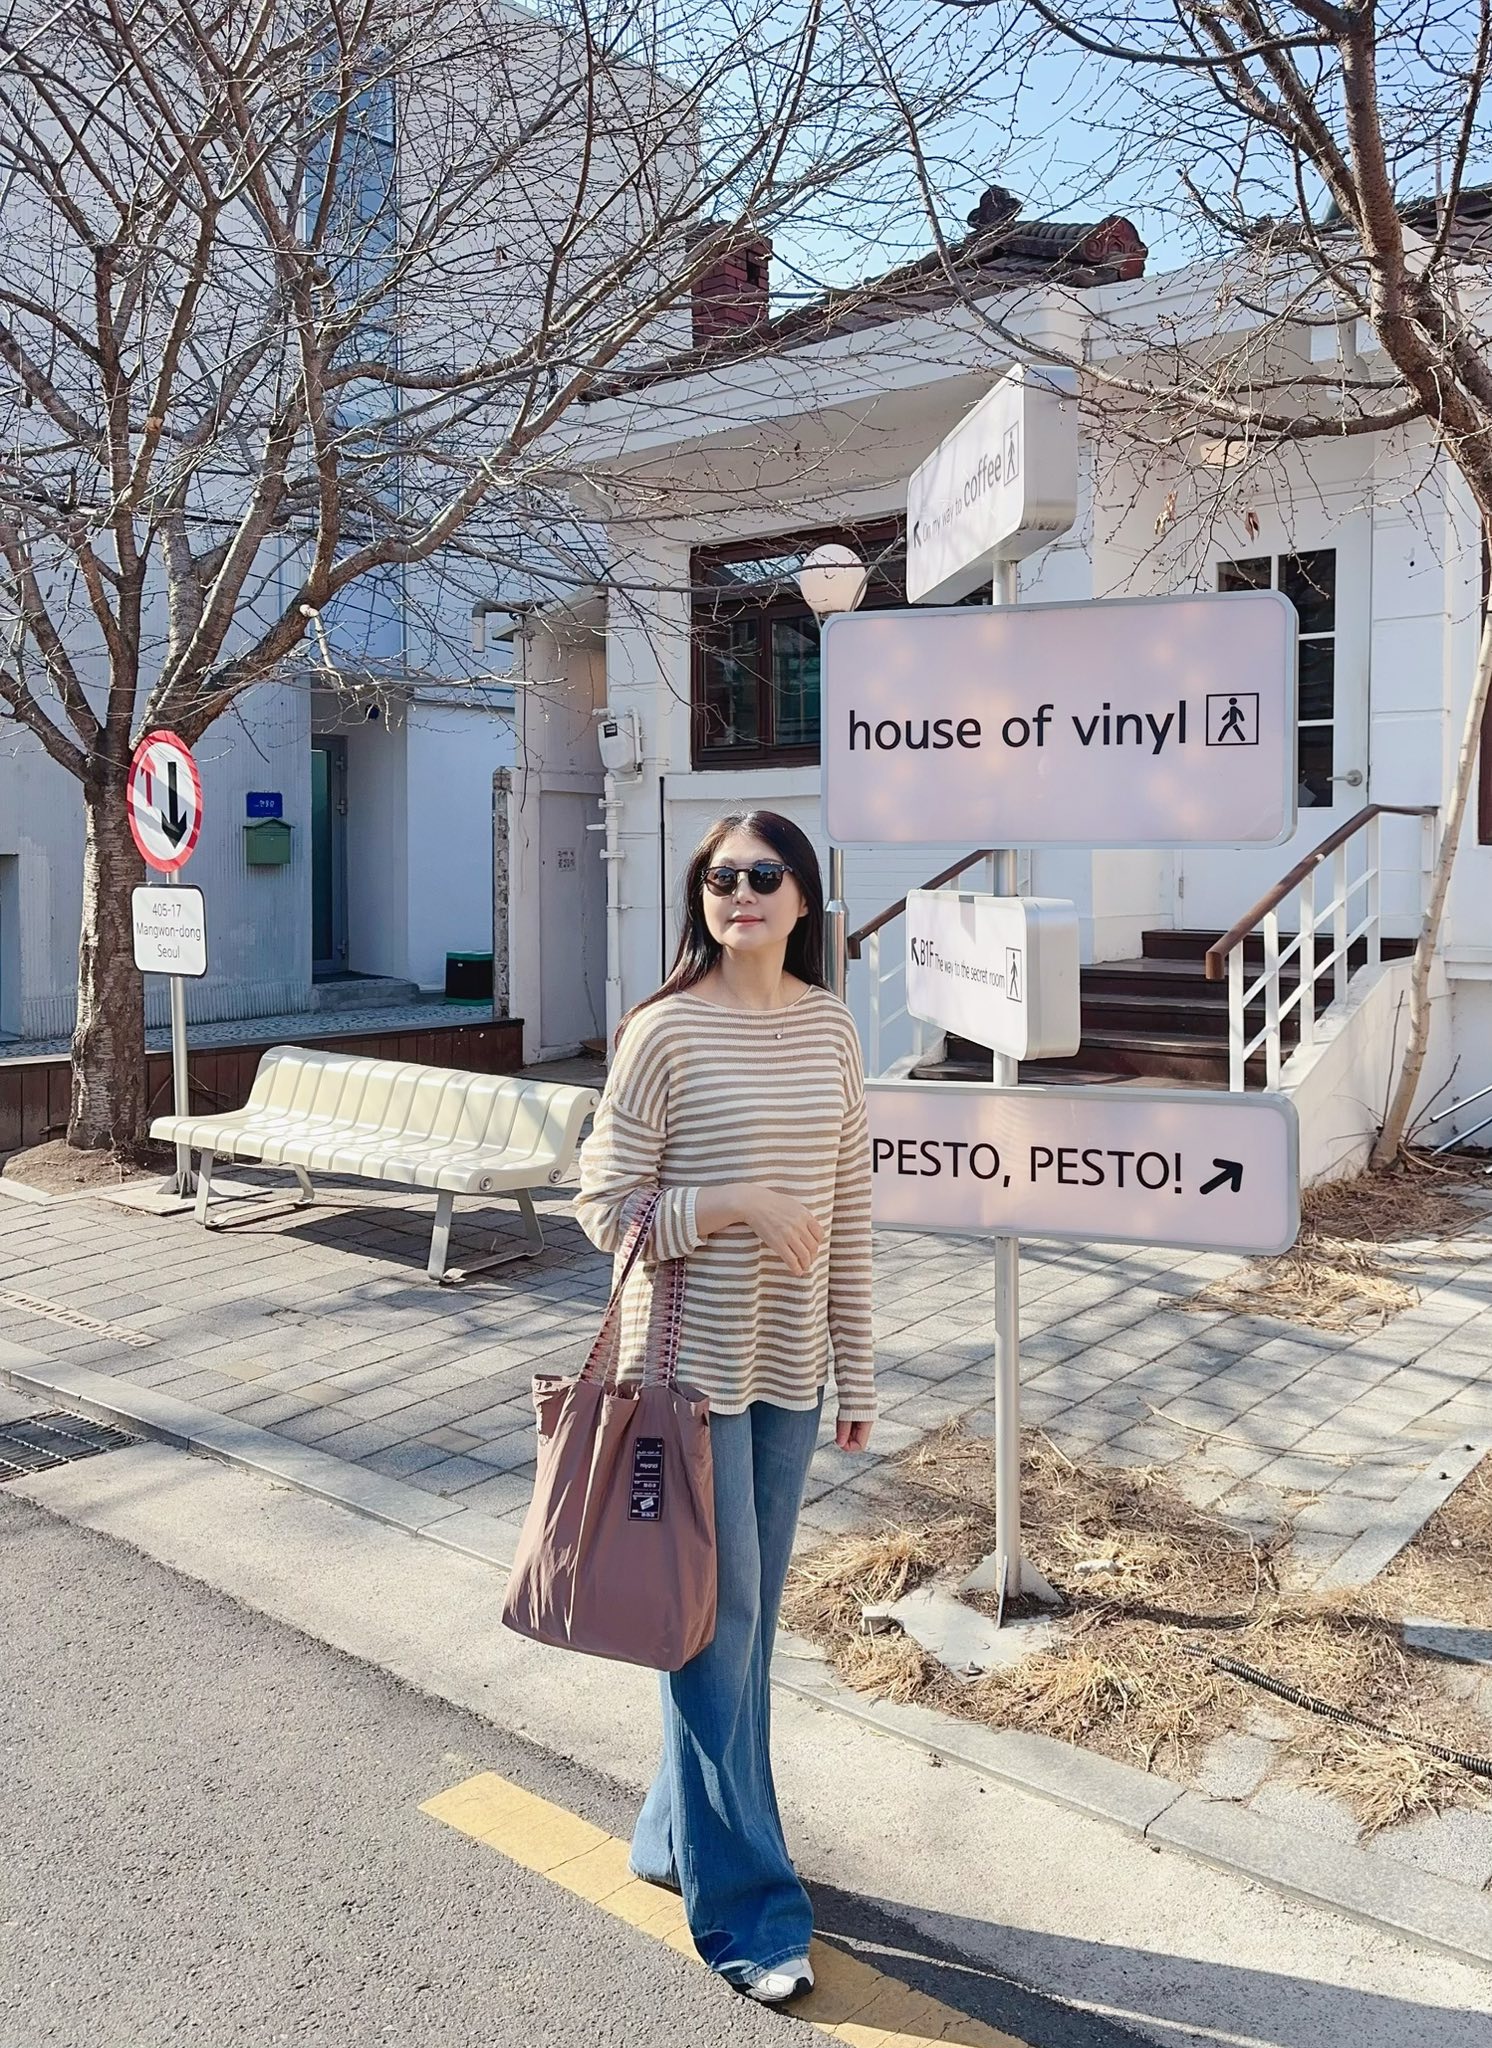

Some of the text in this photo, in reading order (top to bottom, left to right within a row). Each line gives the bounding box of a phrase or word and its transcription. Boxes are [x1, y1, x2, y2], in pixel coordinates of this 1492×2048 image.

[932, 515, 941, 536] my
[942, 504, 954, 527] way
[955, 498, 963, 516] to
[963, 453, 1002, 508] coffee
[849, 700, 1186, 755] house of vinyl
[136, 922, 201, 941] Mangwon-dong
[152, 903, 181, 917] 405-17
[157, 943, 180, 958] Seoul
[920, 939, 1005, 988] B1F The way to the secret room
[873, 1138, 1182, 1194] PESTO, PESTO!
